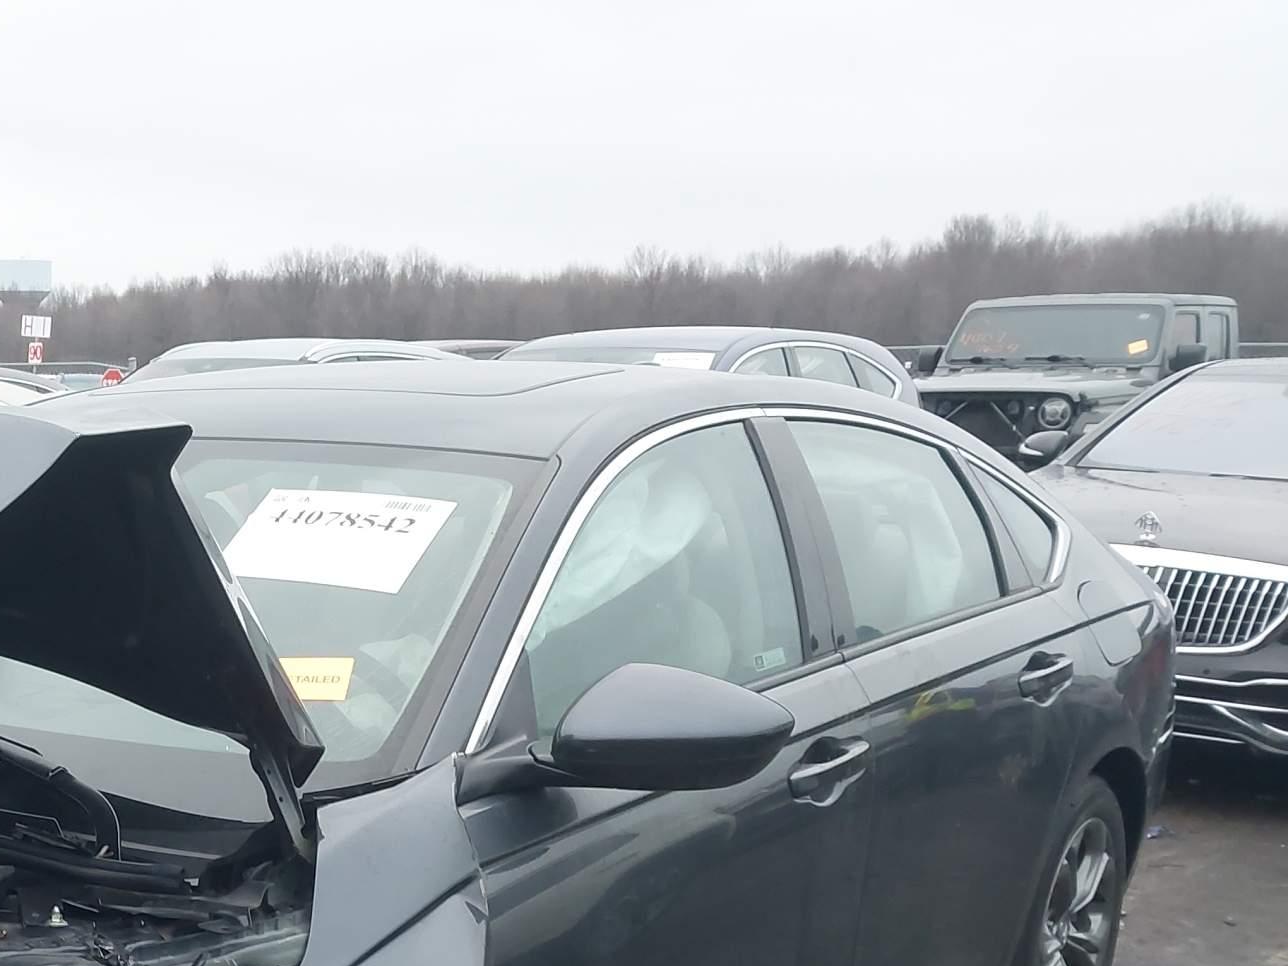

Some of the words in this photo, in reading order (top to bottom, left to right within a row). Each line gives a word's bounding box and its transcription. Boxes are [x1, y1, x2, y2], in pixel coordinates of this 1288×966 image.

[29, 345, 43, 361] 90
[270, 508, 417, 534] 44078542
[291, 674, 342, 684] TAILED
